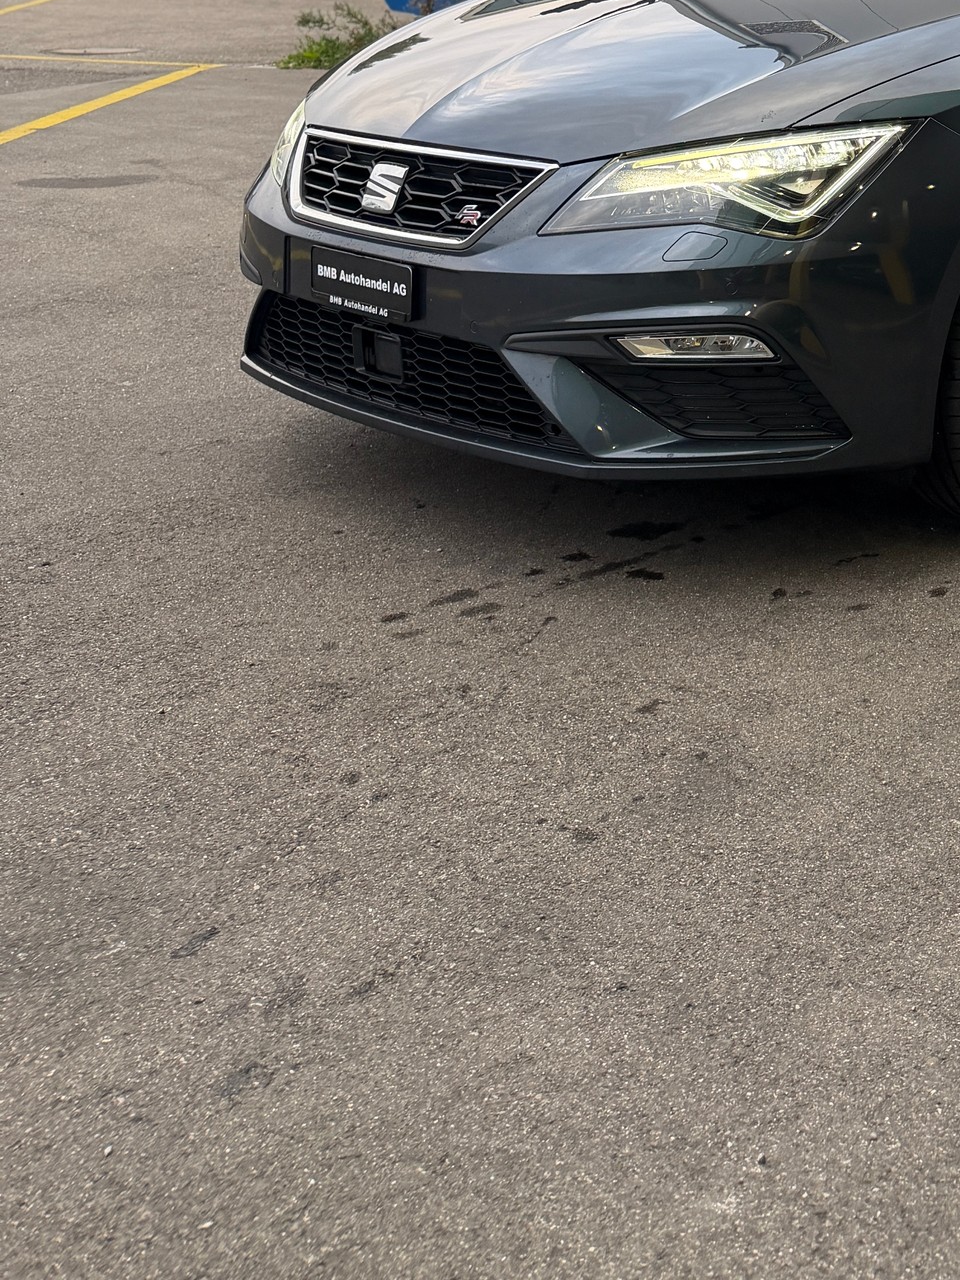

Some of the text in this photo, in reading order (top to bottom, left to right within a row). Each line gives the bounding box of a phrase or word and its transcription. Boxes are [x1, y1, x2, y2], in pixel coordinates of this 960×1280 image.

[317, 264, 407, 296] BMB Autohandel AG
[343, 299, 378, 315] Autohandel
[378, 307, 388, 317] AG
